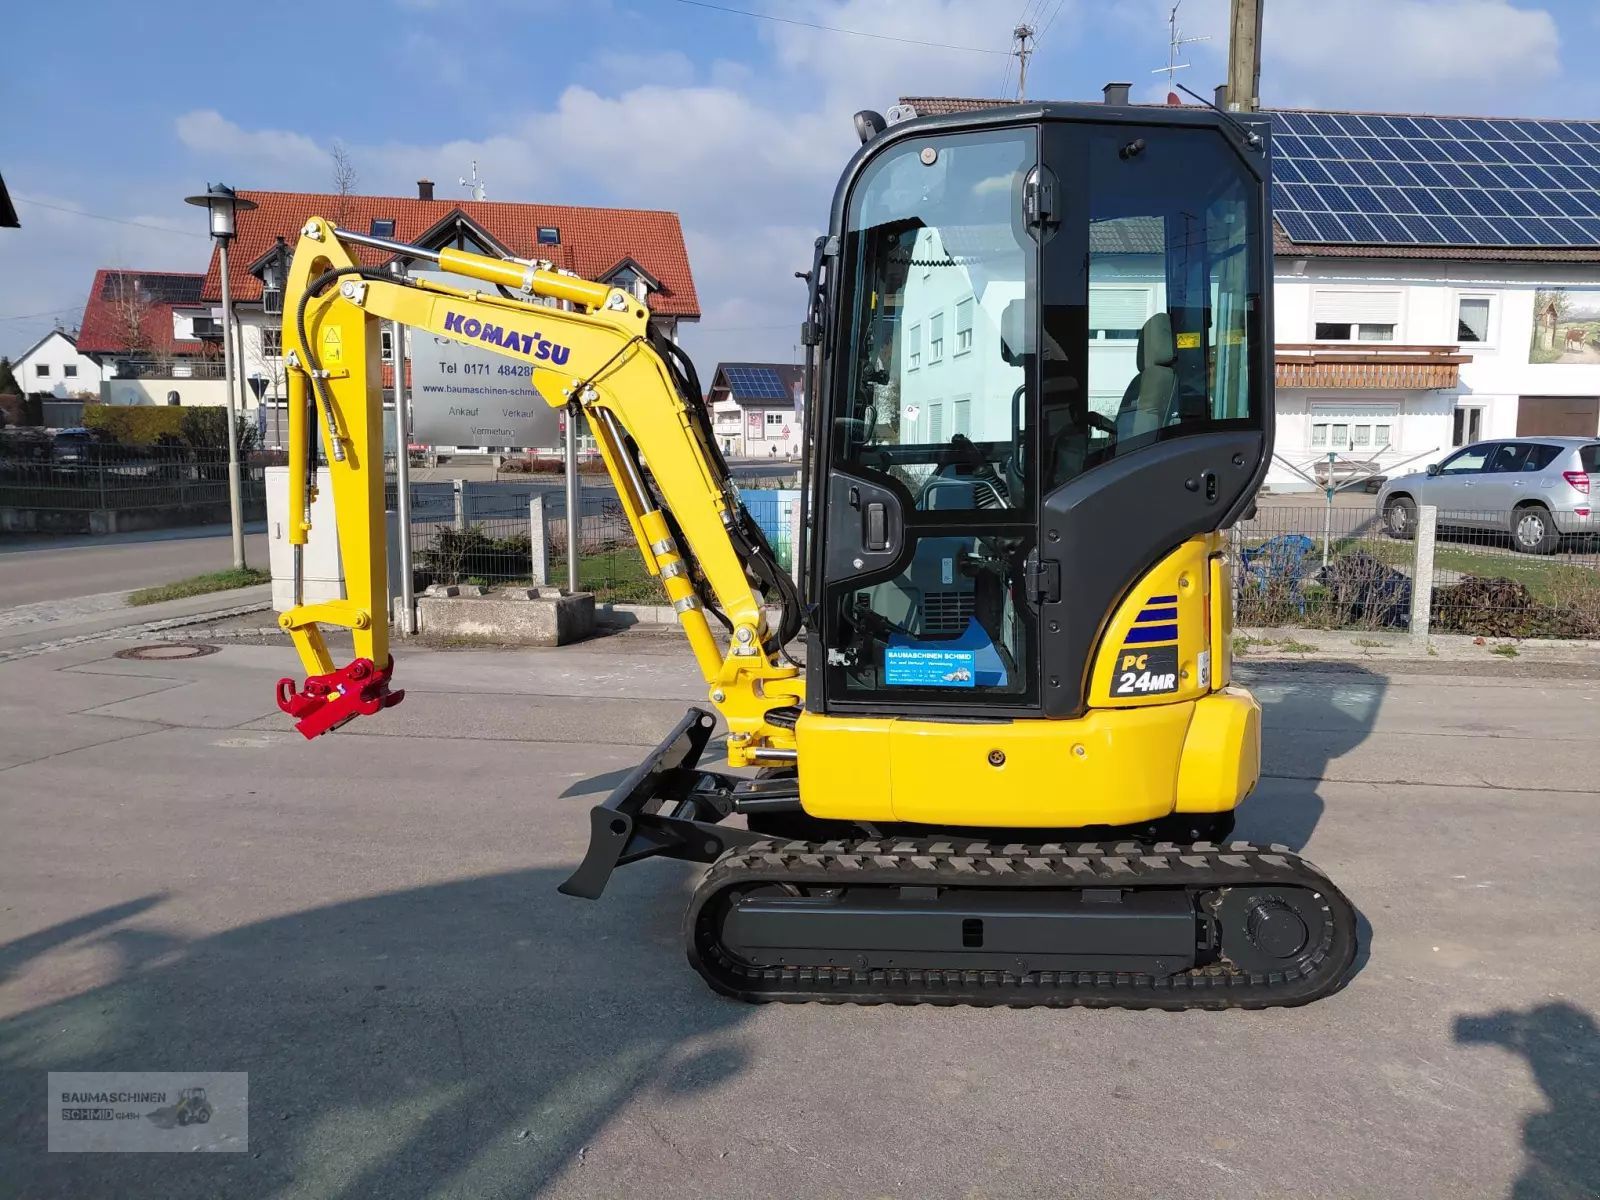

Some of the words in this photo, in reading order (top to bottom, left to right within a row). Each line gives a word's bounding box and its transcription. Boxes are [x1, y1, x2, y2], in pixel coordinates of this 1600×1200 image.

[439, 361, 457, 374] Tel
[464, 363, 490, 375] 0171
[449, 406, 480, 417] Ankauf
[502, 408, 534, 418] Verkauf
[471, 426, 516, 437] Vermietung
[888, 651, 943, 660] BAUMASCHINEN
[1121, 654, 1149, 672] PC
[1116, 671, 1176, 693] 24MR
